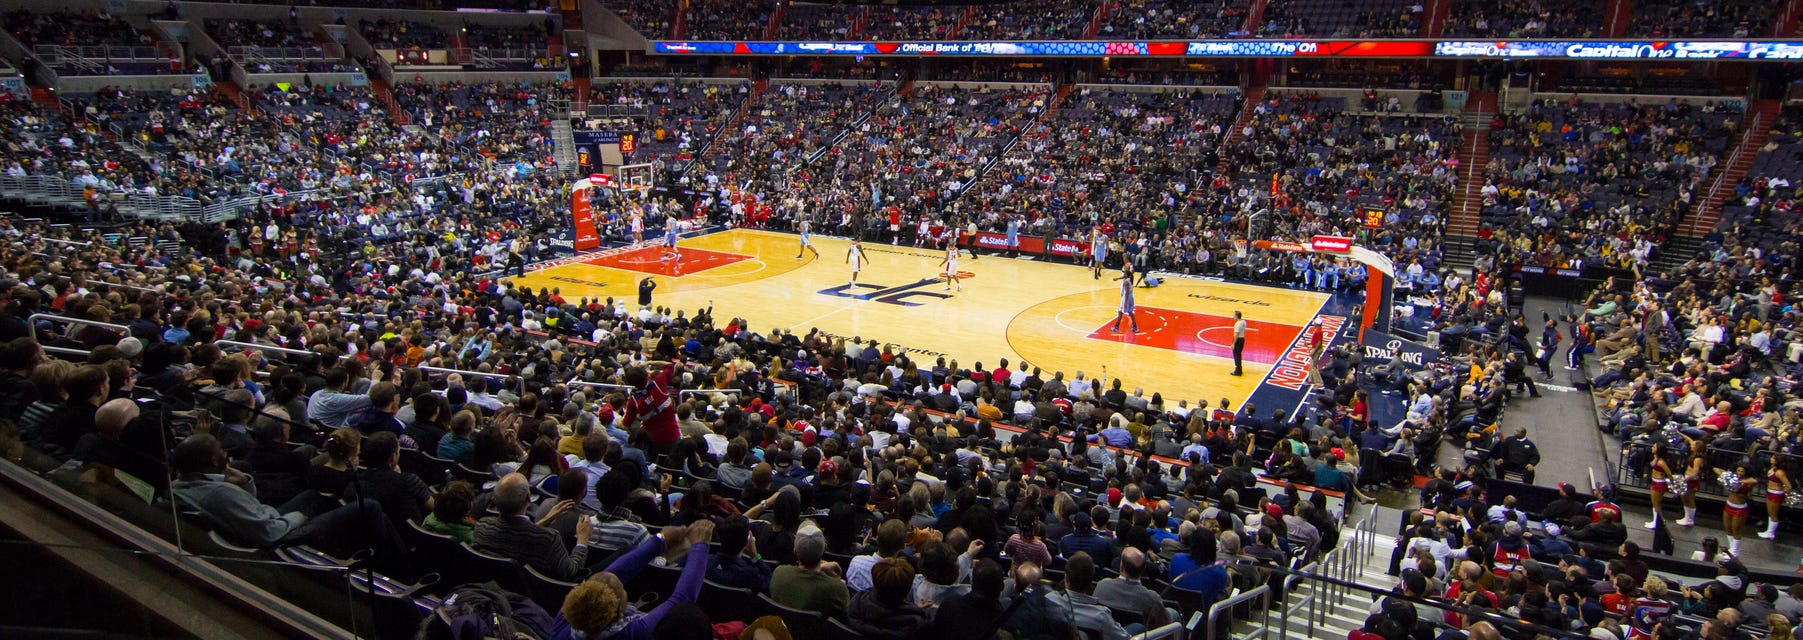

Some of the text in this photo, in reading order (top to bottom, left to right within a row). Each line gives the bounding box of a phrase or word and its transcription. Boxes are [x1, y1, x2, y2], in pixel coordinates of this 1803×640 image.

[902, 43, 932, 52] Official
[936, 43, 959, 52] Bank
[962, 43, 972, 52] of
[623, 140, 633, 150] 20
[1367, 217, 1378, 226] 20
[1187, 293, 1270, 307] wizards
[1364, 345, 1423, 366] SPALING
